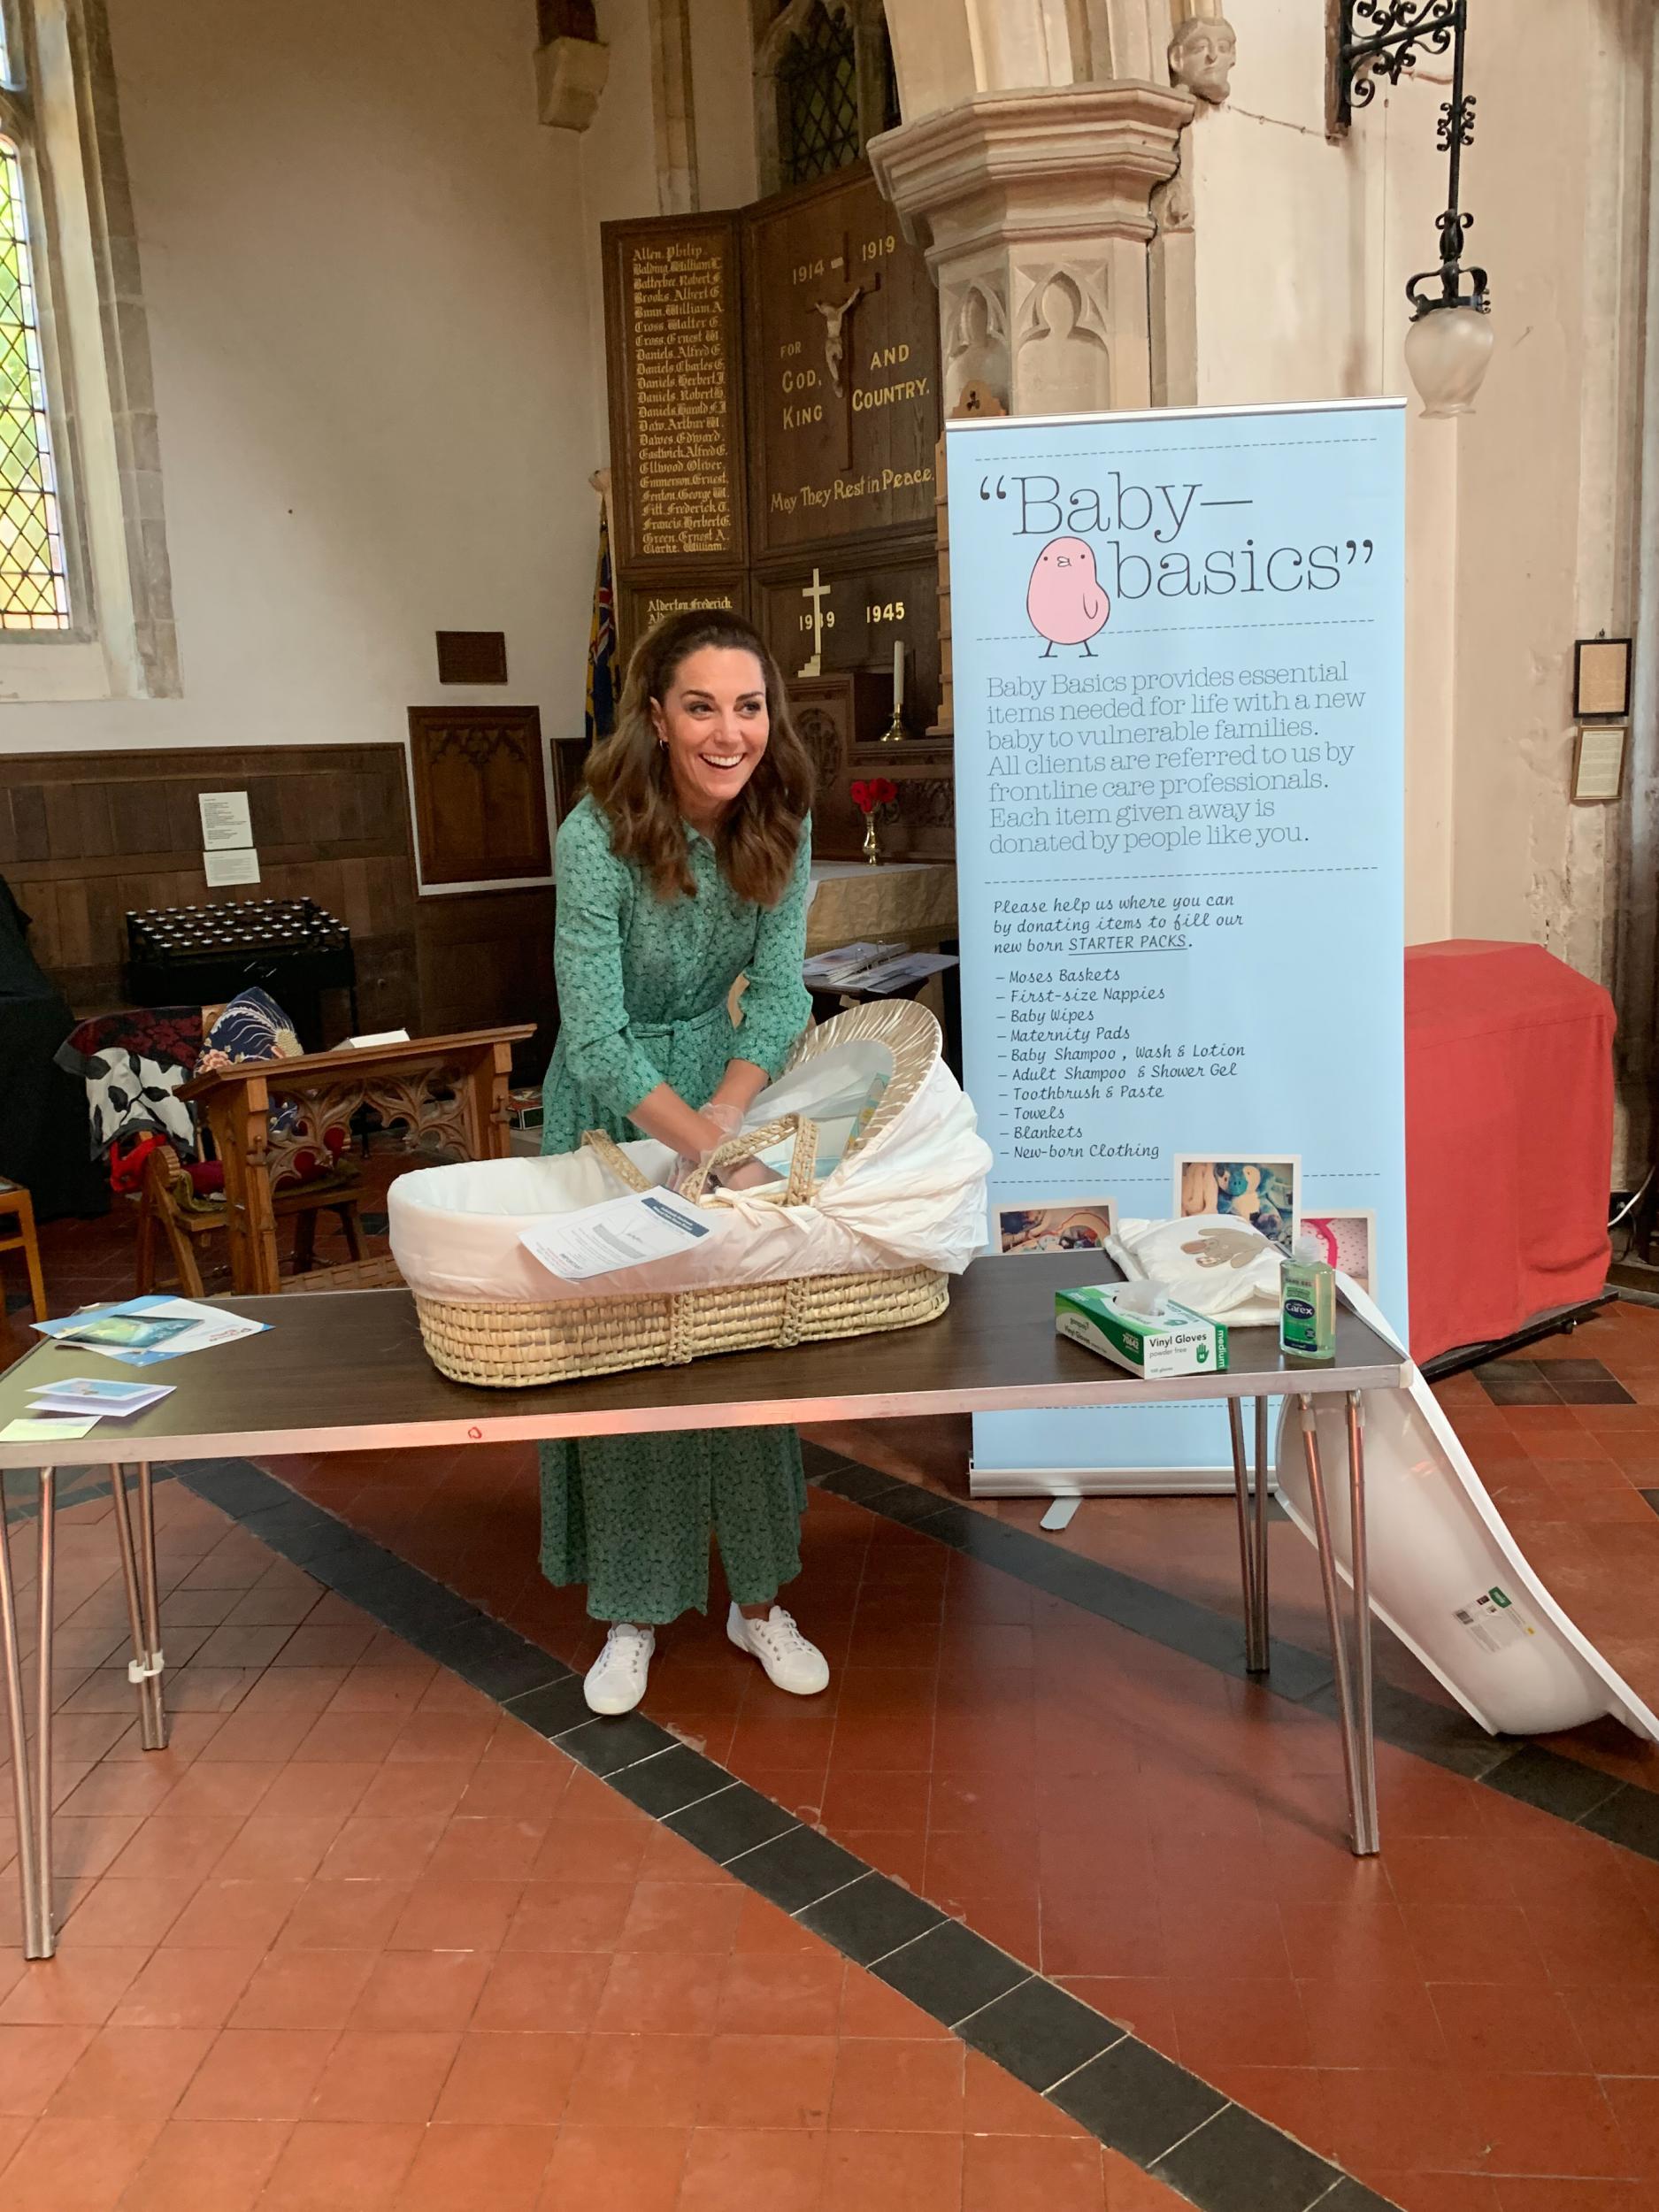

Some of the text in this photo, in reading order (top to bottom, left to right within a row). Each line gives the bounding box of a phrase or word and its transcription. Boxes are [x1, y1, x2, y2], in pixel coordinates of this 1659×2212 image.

[793, 234, 895, 285] 1914 1919
[780, 342, 802, 358] FOR
[871, 344, 910, 371] AND
[783, 405, 823, 430] KING
[771, 493, 797, 514] May
[801, 486, 832, 507] They
[834, 474, 865, 500] Rest
[867, 476, 879, 494] in
[866, 603, 905, 623] 1945
[987, 661, 1349, 701] Baby Basics provides essential
[987, 690, 1366, 724] items needed for life with a new
[987, 718, 1318, 753] baby to vulnerable families.
[987, 741, 1356, 776] All clients are referred to us by
[988, 769, 1329, 803] frontline care professionals.
[989, 798, 1275, 828] Each item given away is
[989, 825, 1310, 854] donated by people like you.
[994, 895, 1233, 914] Please help us where you can
[994, 912, 1244, 936] by donating items to fill our
[994, 934, 1193, 954] new born STARTER PACKS.
[1009, 967, 1120, 984] Moses Baskets
[1010, 986, 1165, 1003] First-size Nappies
[1010, 1007, 1094, 1025] Baby Wipes
[1010, 1025, 1131, 1043] Maternity Pads
[1011, 1048, 1047, 1064] Baby
[1135, 1043, 1171, 1058] Wash
[1177, 1045, 1186, 1057] &
[1193, 1043, 1246, 1057] Lotion
[1012, 1062, 1238, 1082] Adult Shampoo & Shower Gel
[1013, 1084, 1164, 1100] Toothbrush & Paste
[1013, 1106, 1064, 1119] Towels
[1014, 1125, 1083, 1139] Blankets
[1014, 1143, 1160, 1159] New-born Clothing
[1286, 1302, 1313, 1315] Carex
[1149, 1333, 1207, 1349] Vinyl Gloves
[1217, 1330, 1225, 1369] medium
